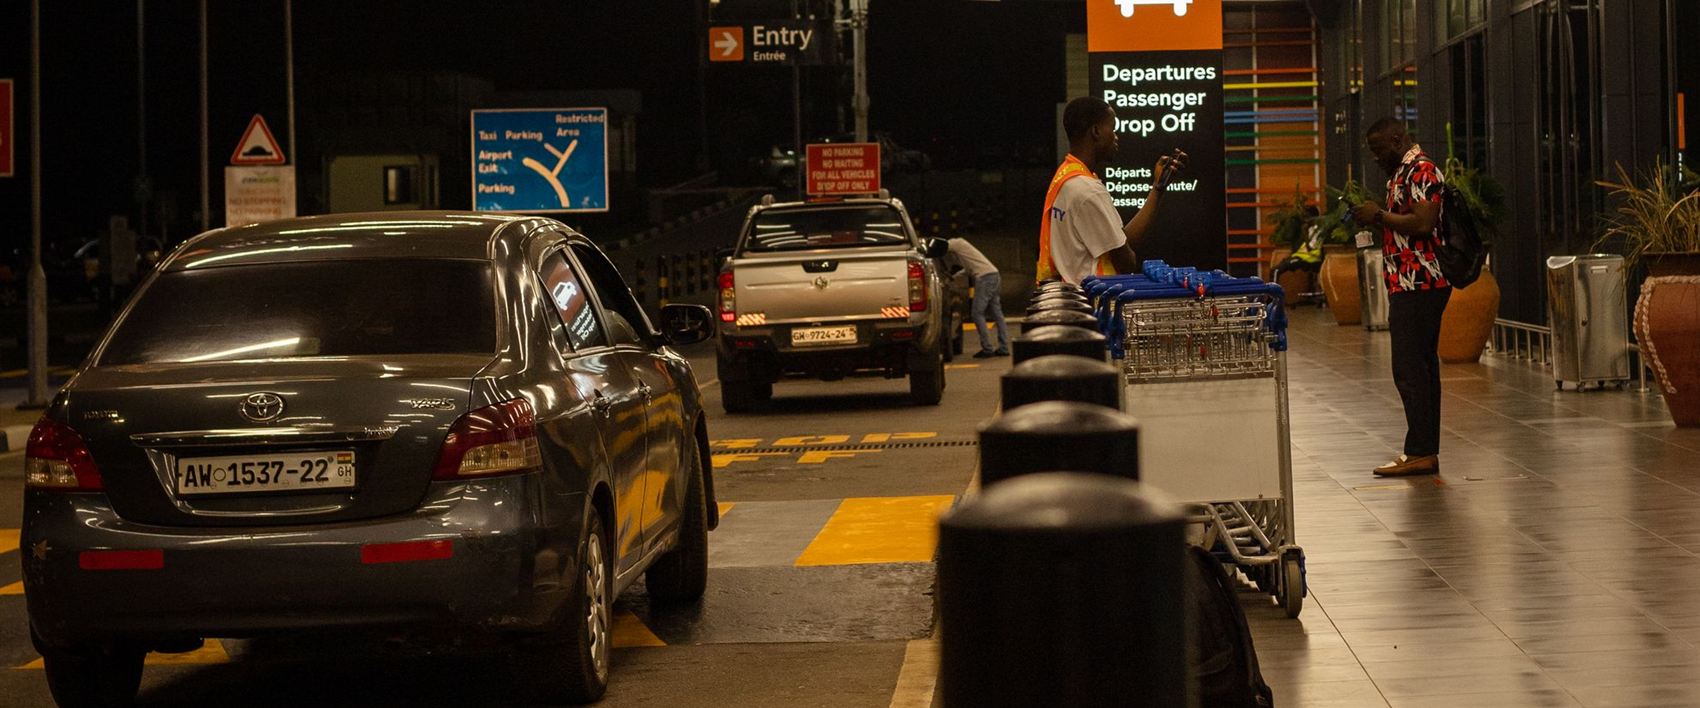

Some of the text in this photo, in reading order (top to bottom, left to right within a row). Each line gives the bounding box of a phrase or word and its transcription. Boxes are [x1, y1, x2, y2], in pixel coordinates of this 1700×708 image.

[753, 26, 812, 51] Entry
[753, 51, 786, 61] Entrée
[1103, 64, 1216, 86] Departures
[1103, 89, 1206, 111] Passenger
[556, 114, 604, 124] Restricted
[1161, 113, 1196, 132] Off
[478, 130, 543, 141] Taxi Parking
[556, 127, 580, 137] Area
[478, 150, 512, 161] Airport
[822, 147, 864, 157] NO PARKING
[478, 163, 498, 173] Exit
[822, 159, 864, 168] NO WAITING
[812, 169, 875, 180] FOR ALL VEHICLES
[1105, 167, 1152, 180] Départs
[478, 184, 515, 195] Parking
[836, 181, 850, 190] OFF
[851, 181, 870, 190] ONLY
[1106, 179, 1198, 194] Dépose-nute/
[1111, 196, 1148, 209] assag
[810, 329, 846, 340] 9724-24
[184, 459, 352, 488] AW 1537-22 GH
